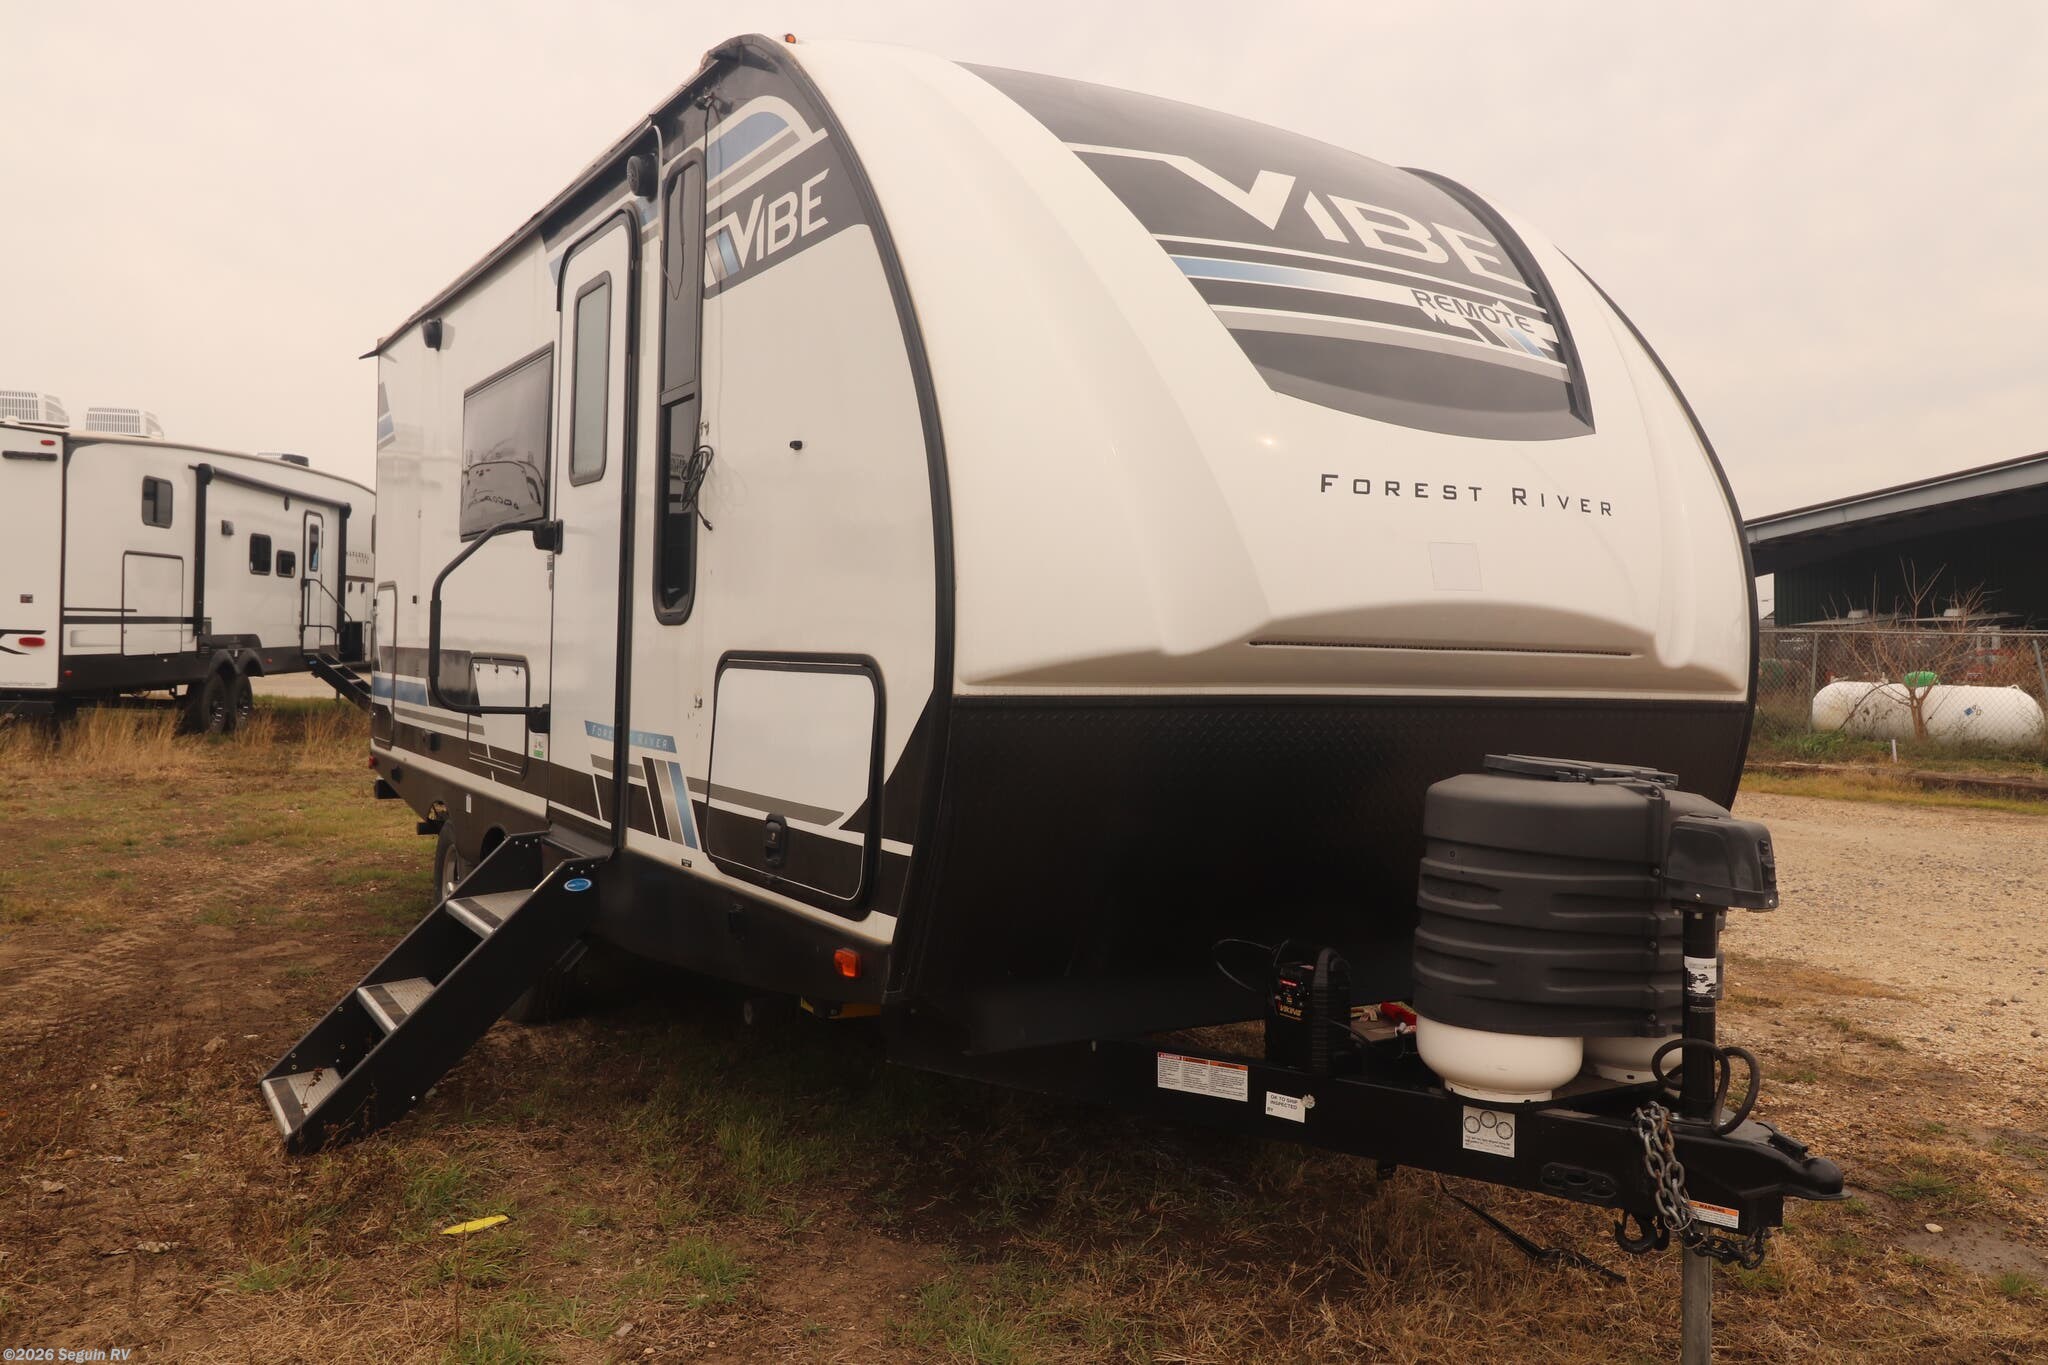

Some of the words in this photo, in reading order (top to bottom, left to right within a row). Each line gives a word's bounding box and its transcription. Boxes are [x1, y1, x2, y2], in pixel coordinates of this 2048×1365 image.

[718, 168, 830, 270] VIBE
[1163, 157, 1536, 295] VIBE
[1411, 289, 1535, 334] REMOTE
[1320, 473, 1483, 501] FOREST
[1511, 487, 1612, 516] RIVER
[1270, 1100, 1298, 1110] INSPECTED
